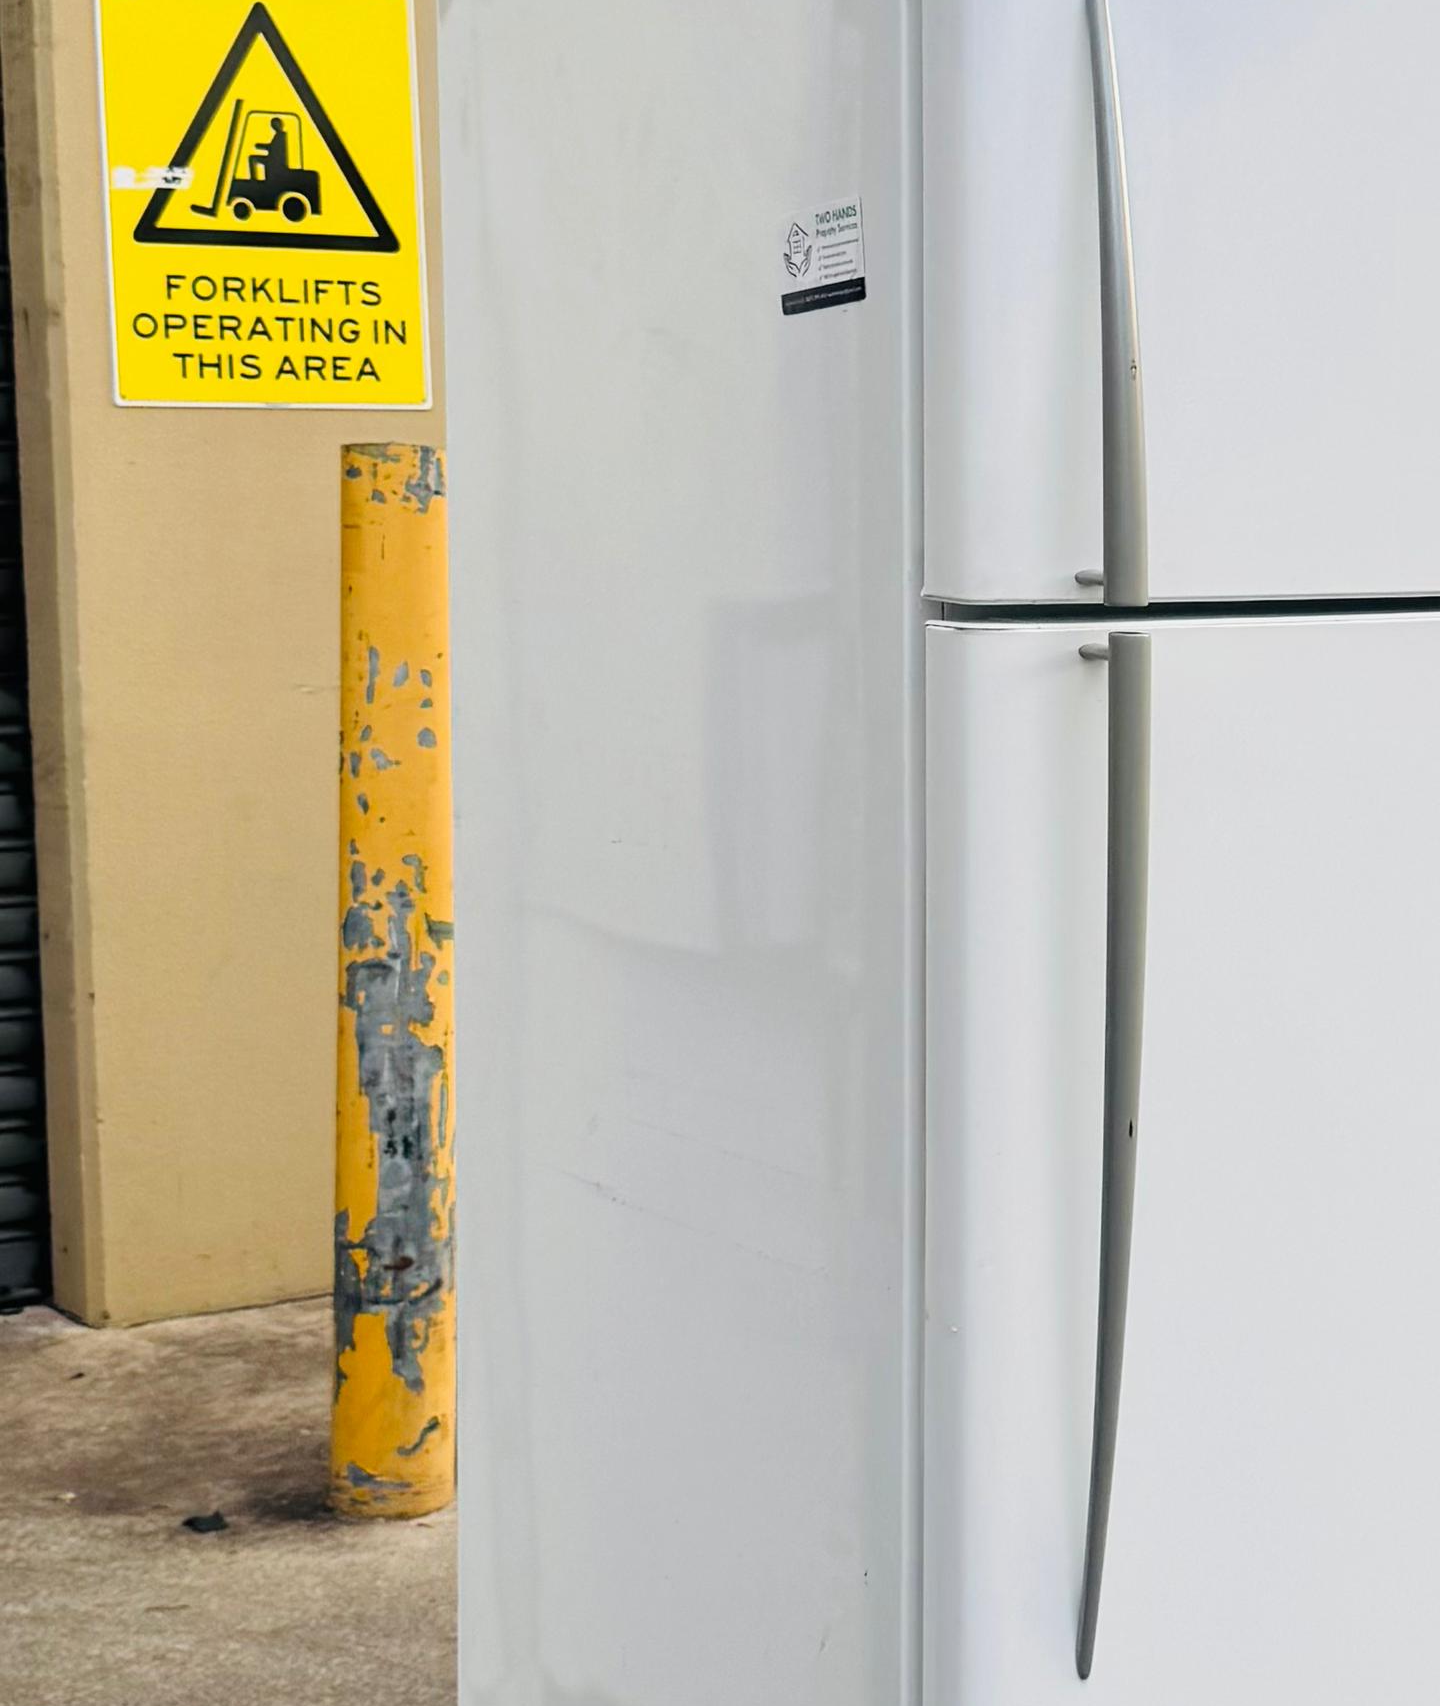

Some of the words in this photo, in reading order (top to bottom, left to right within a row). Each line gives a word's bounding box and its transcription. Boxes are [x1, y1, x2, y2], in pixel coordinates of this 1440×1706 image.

[832, 205, 857, 222] HANDS
[165, 274, 383, 307] FORKLIFTS
[132, 312, 361, 344] OPERATING
[372, 319, 408, 345] IN
[173, 353, 263, 381] THIS
[275, 354, 382, 382] AREA
